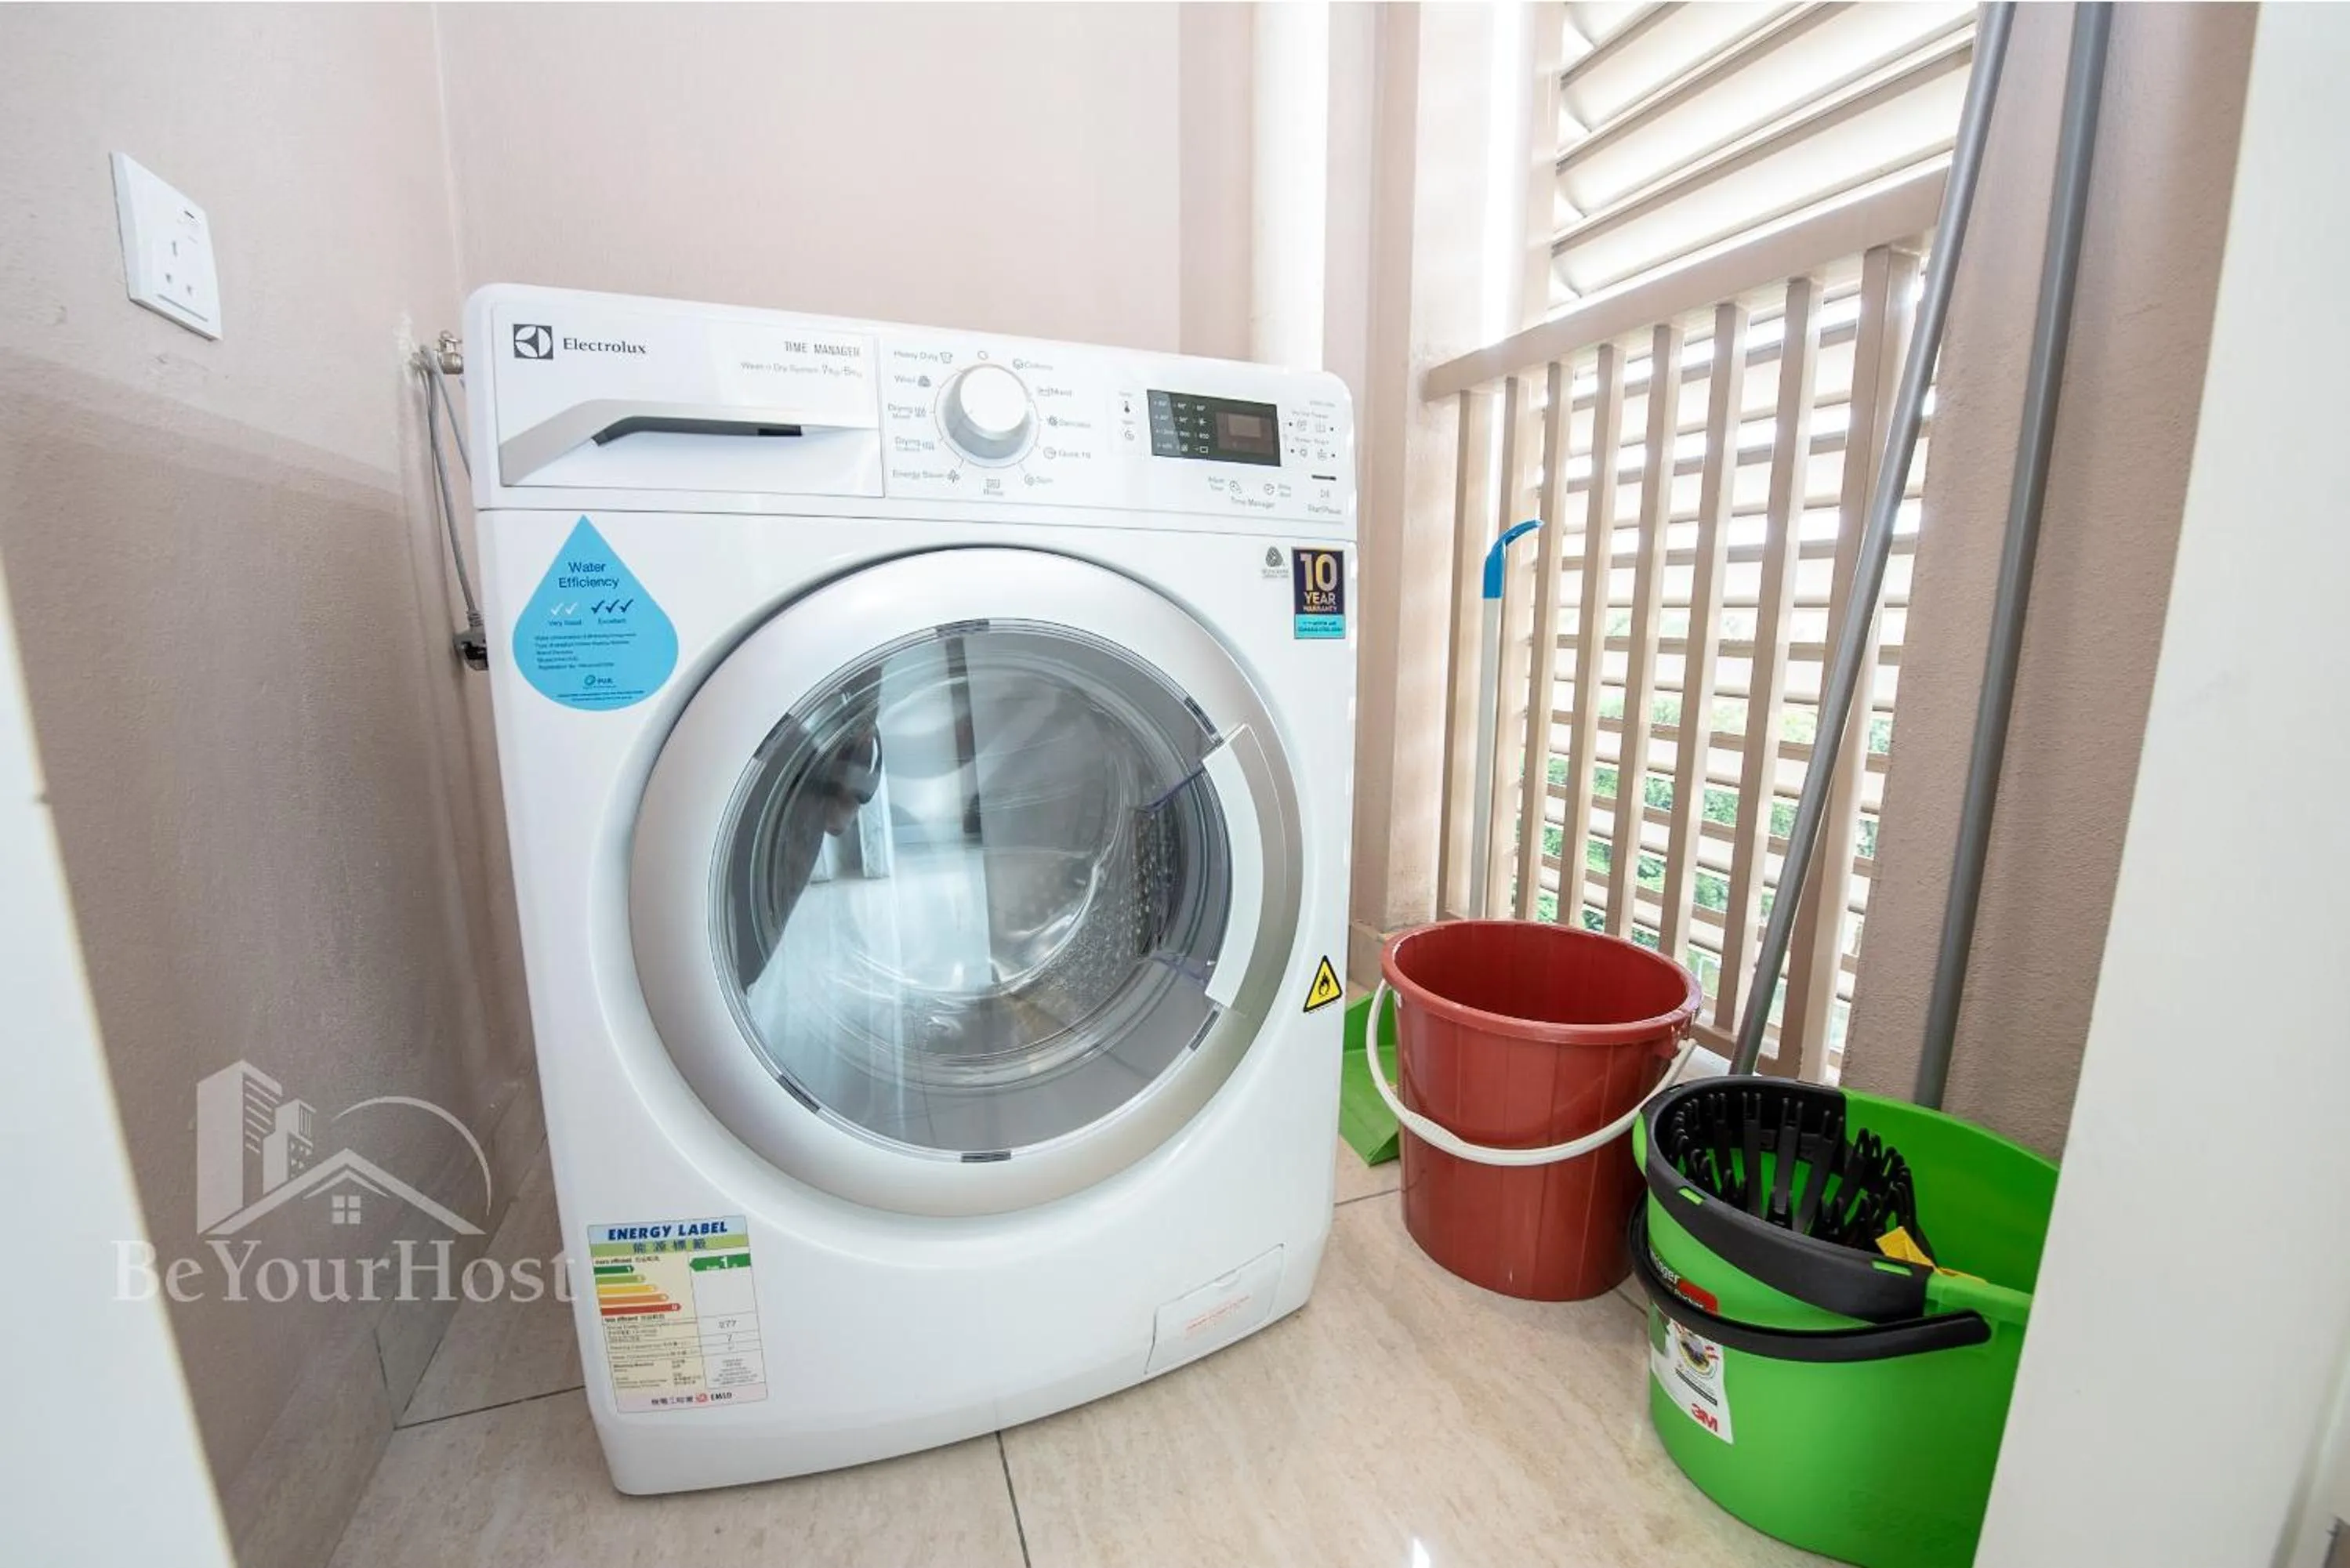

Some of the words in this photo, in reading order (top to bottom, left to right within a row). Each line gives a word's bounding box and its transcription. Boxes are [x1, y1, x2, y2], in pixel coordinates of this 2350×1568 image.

[563, 336, 647, 355] Electrolux
[784, 340, 808, 353] TIME
[568, 561, 606, 573] Water
[1300, 552, 1337, 592] 10
[558, 576, 619, 589] Efficiency
[1304, 592, 1336, 605] YEAR
[608, 1225, 672, 1240] ENERGY
[678, 1221, 727, 1237] LABEL
[1691, 1403, 1718, 1432] 3M
